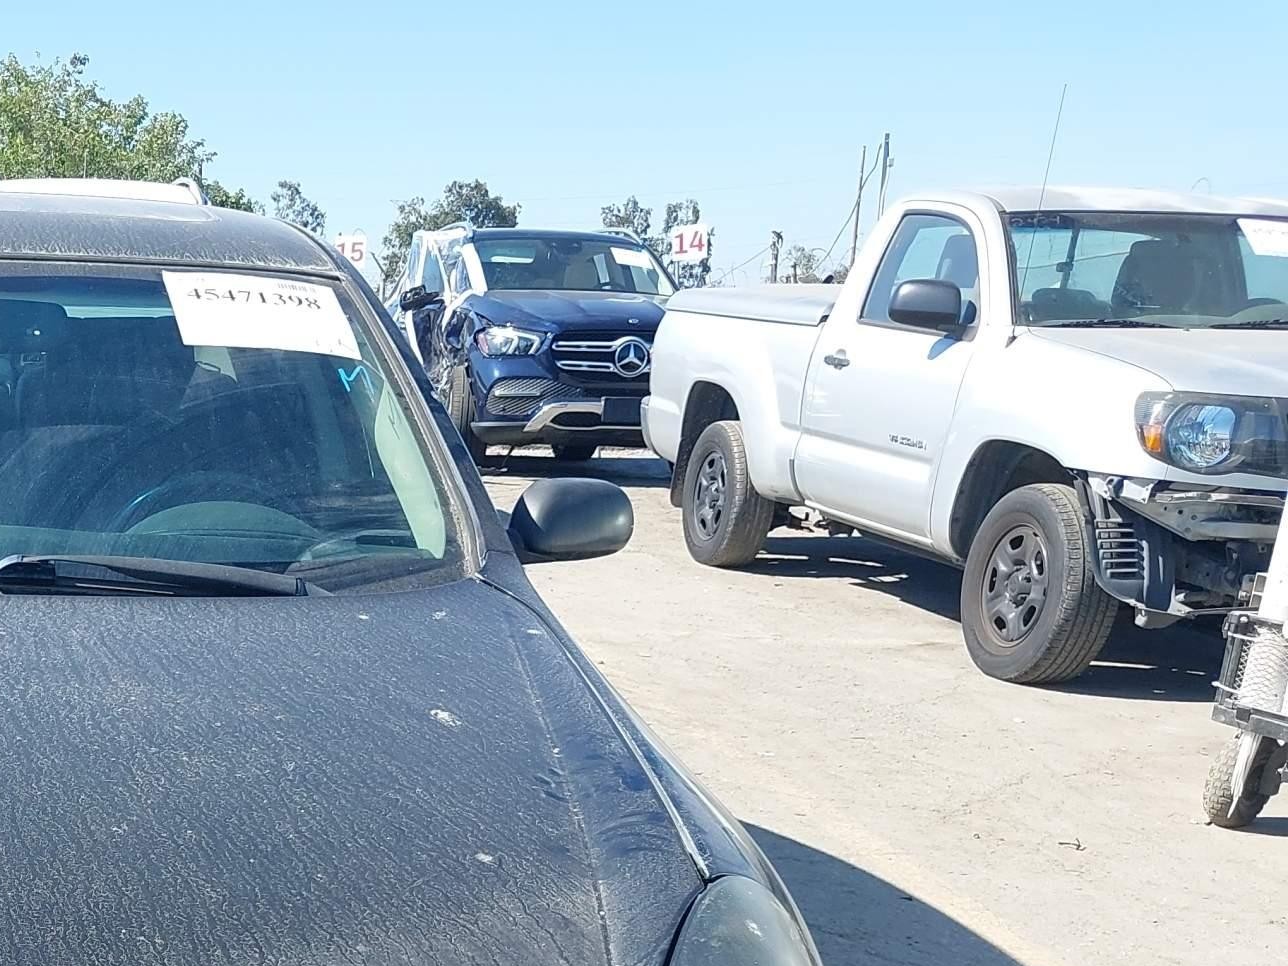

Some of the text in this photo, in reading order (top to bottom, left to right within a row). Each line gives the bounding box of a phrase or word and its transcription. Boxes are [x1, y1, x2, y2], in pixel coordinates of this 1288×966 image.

[336, 241, 365, 262] 15
[674, 230, 705, 254] 14
[187, 288, 321, 310] 45471398
